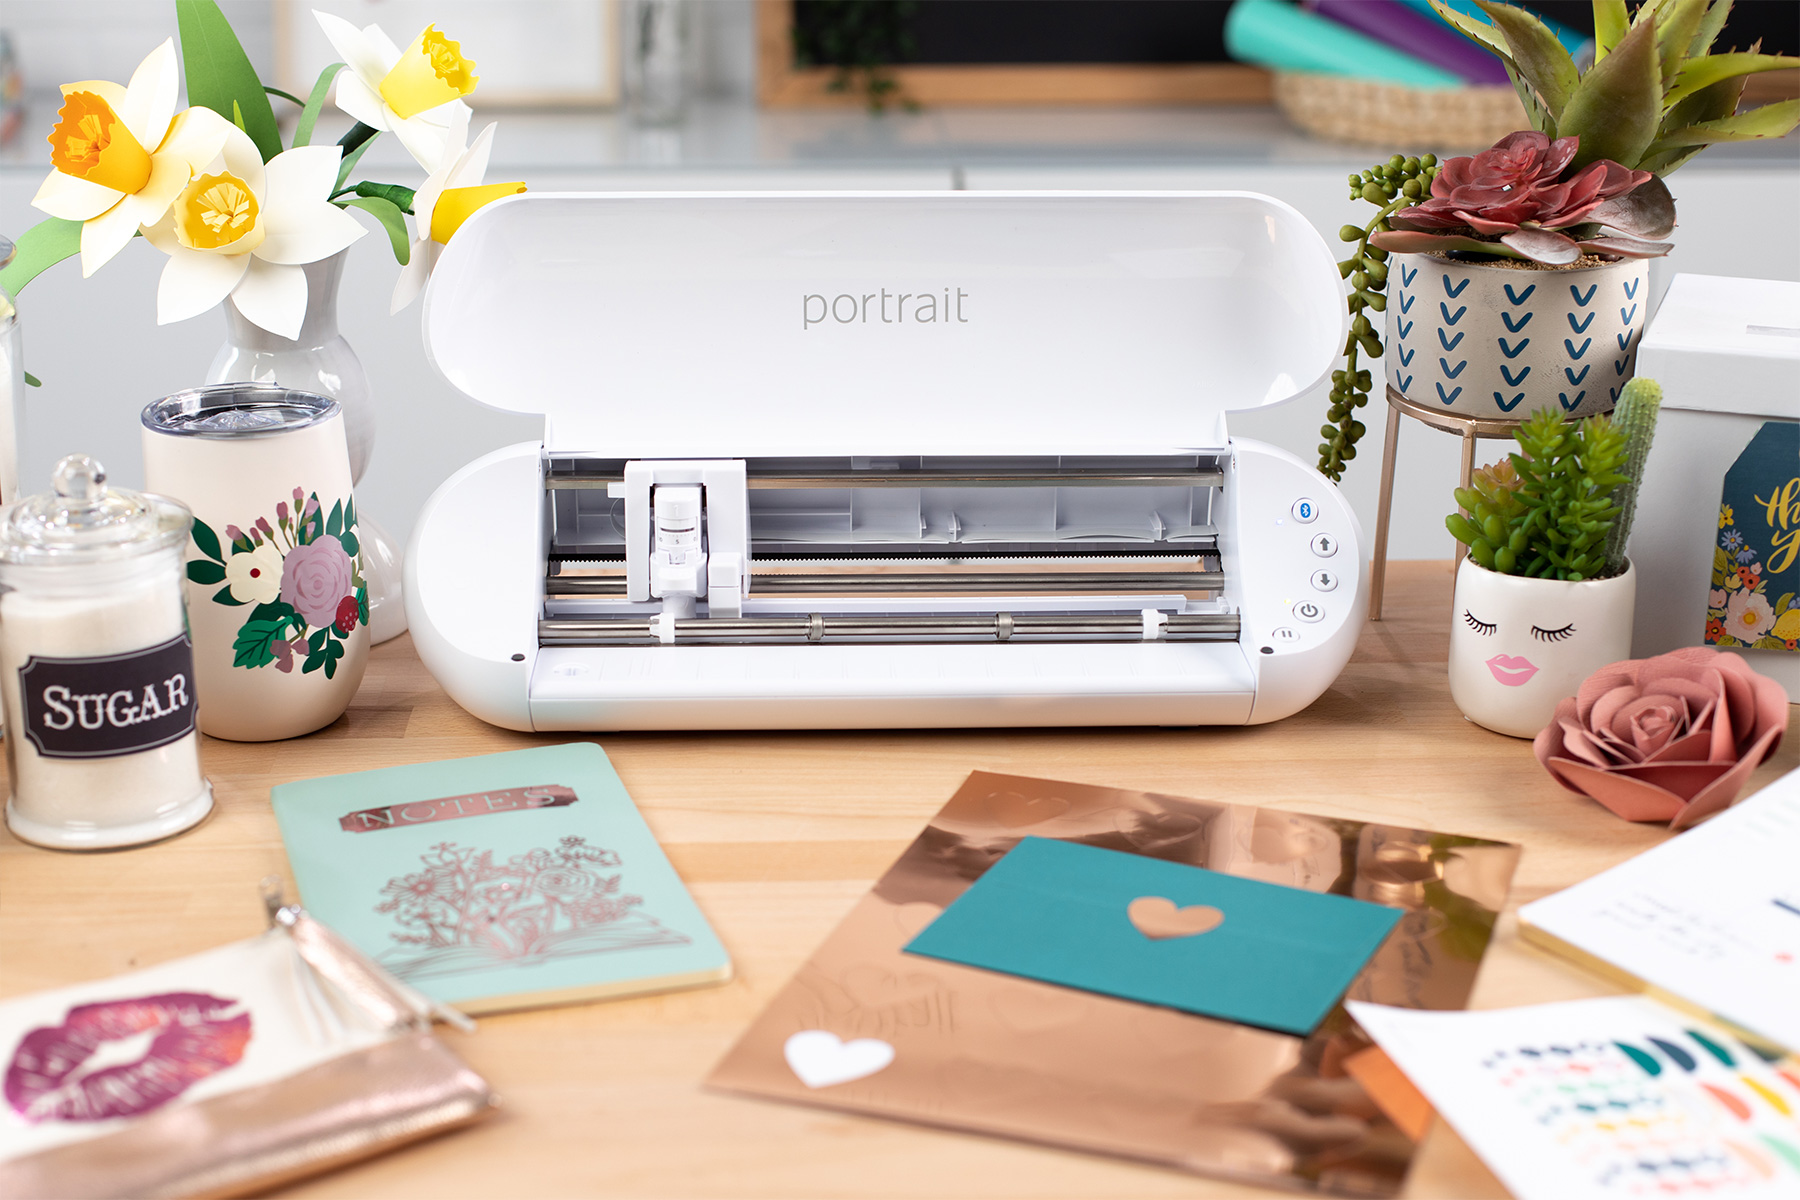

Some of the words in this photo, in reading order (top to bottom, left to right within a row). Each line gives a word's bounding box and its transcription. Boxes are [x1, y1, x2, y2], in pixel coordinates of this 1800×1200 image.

[803, 287, 969, 330] portrait
[43, 673, 189, 730] SUGAR
[356, 788, 555, 828] NOTES
